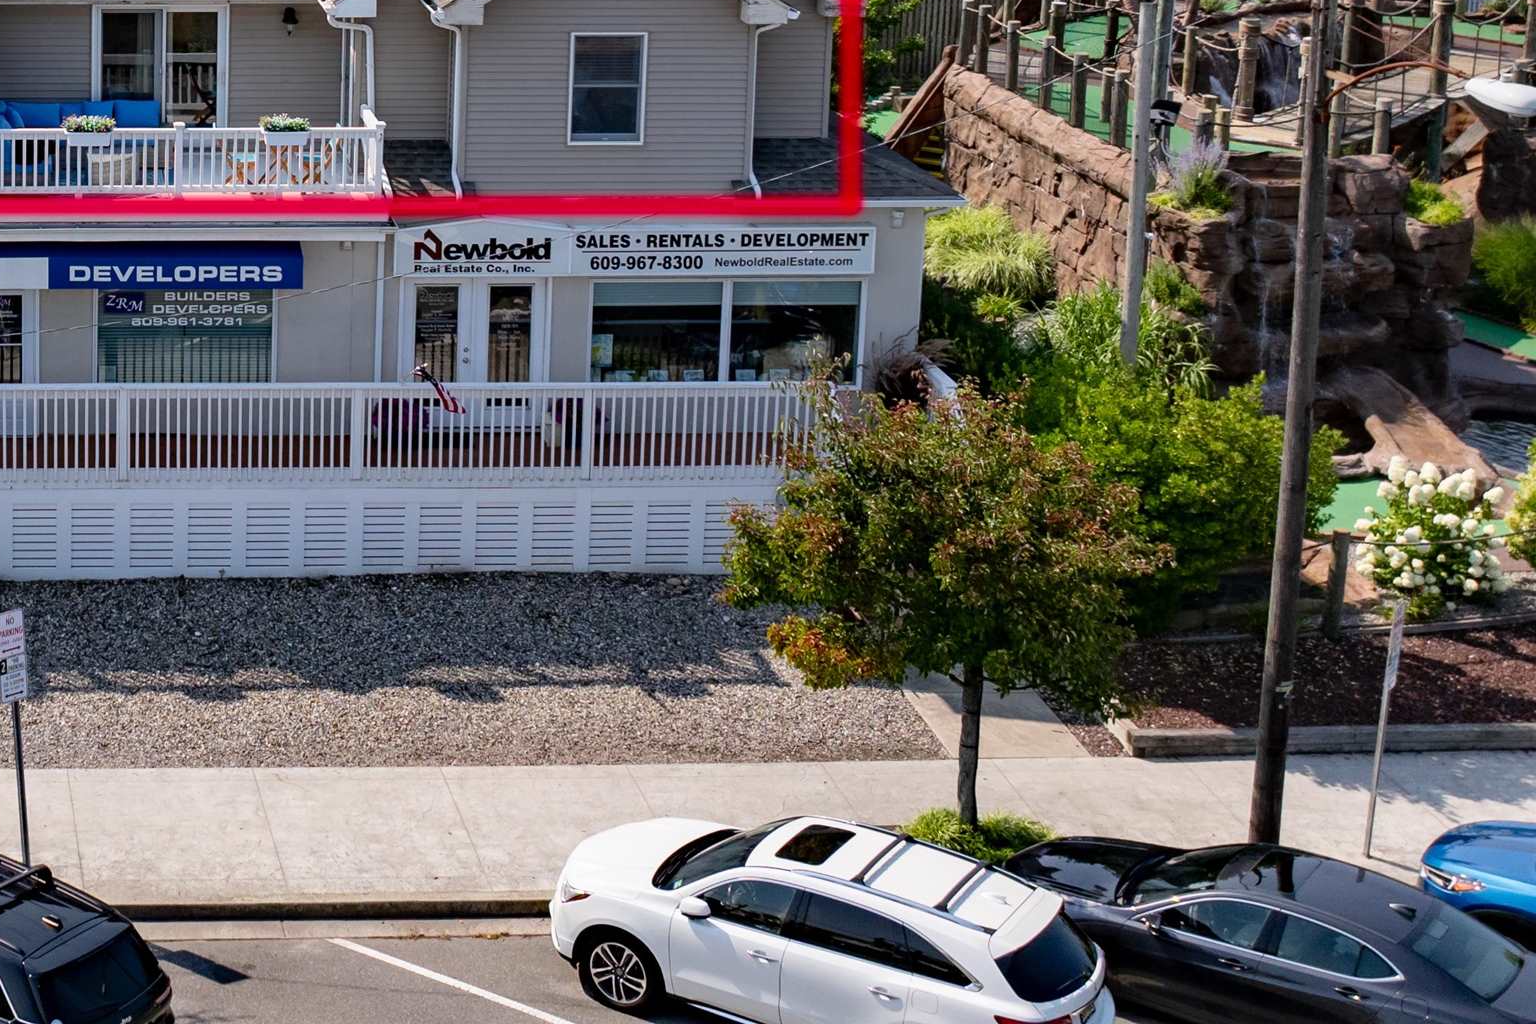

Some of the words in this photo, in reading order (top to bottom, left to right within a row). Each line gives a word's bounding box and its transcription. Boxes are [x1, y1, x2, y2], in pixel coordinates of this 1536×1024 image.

[413, 228, 552, 261] Newbold
[575, 234, 631, 249] SALES
[646, 233, 725, 249] RENTALS
[740, 231, 870, 248] DEVELOPMENT
[413, 263, 441, 274] Real
[444, 263, 483, 274] Estate
[513, 263, 536, 274] Inc.
[589, 254, 704, 271] 609-967-8300
[714, 256, 854, 268] NewboldRealEstate.com
[68, 264, 284, 283] DEVELOPERS
[105, 294, 144, 313] ZRM
[164, 291, 251, 302] BUILDERS
[151, 304, 269, 315] DEVELOPERS
